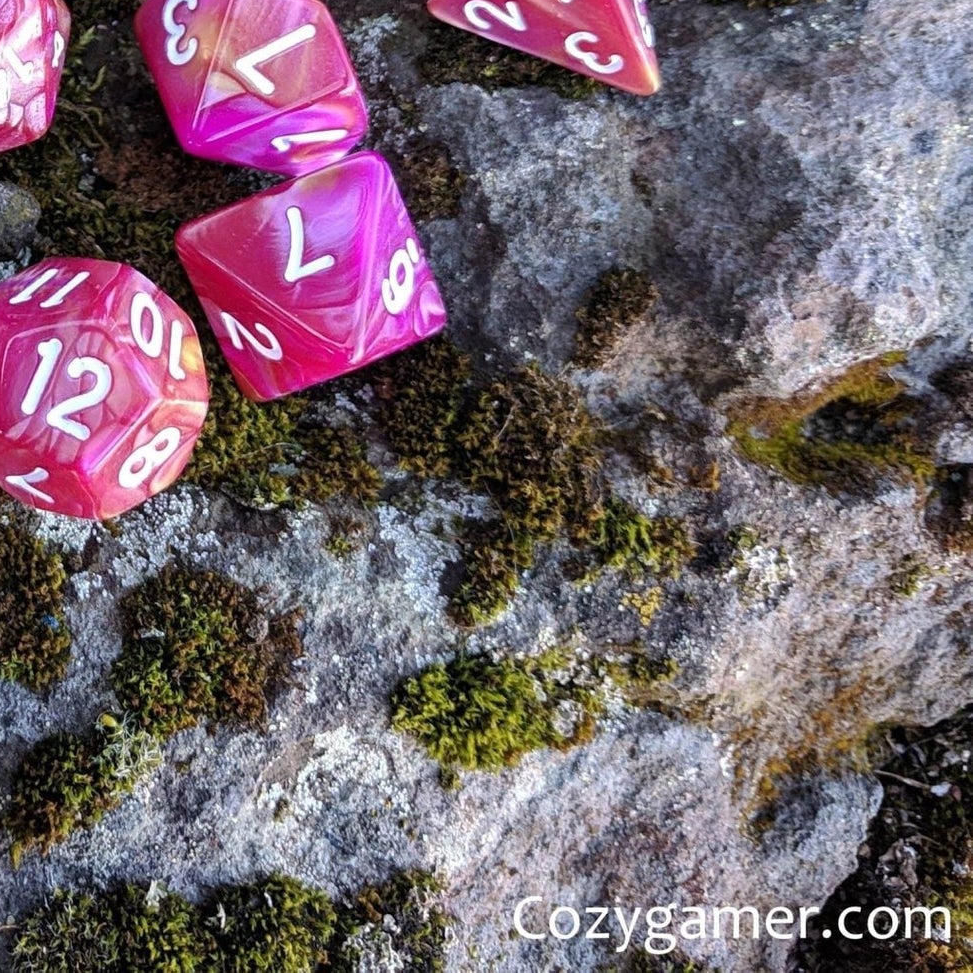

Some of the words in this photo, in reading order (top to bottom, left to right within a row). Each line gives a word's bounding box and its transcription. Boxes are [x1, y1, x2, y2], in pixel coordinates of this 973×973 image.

[464, 0, 526, 32] 2
[235, 24, 316, 95] 7
[565, 31, 624, 74] 3
[270, 129, 348, 152] 1
[284, 205, 335, 282] 7
[9, 268, 90, 308] 11
[130, 292, 185, 380] 10
[221, 311, 283, 361] 2
[21, 338, 113, 441] 12
[119, 426, 181, 489] 8
[5, 466, 55, 504] 7
